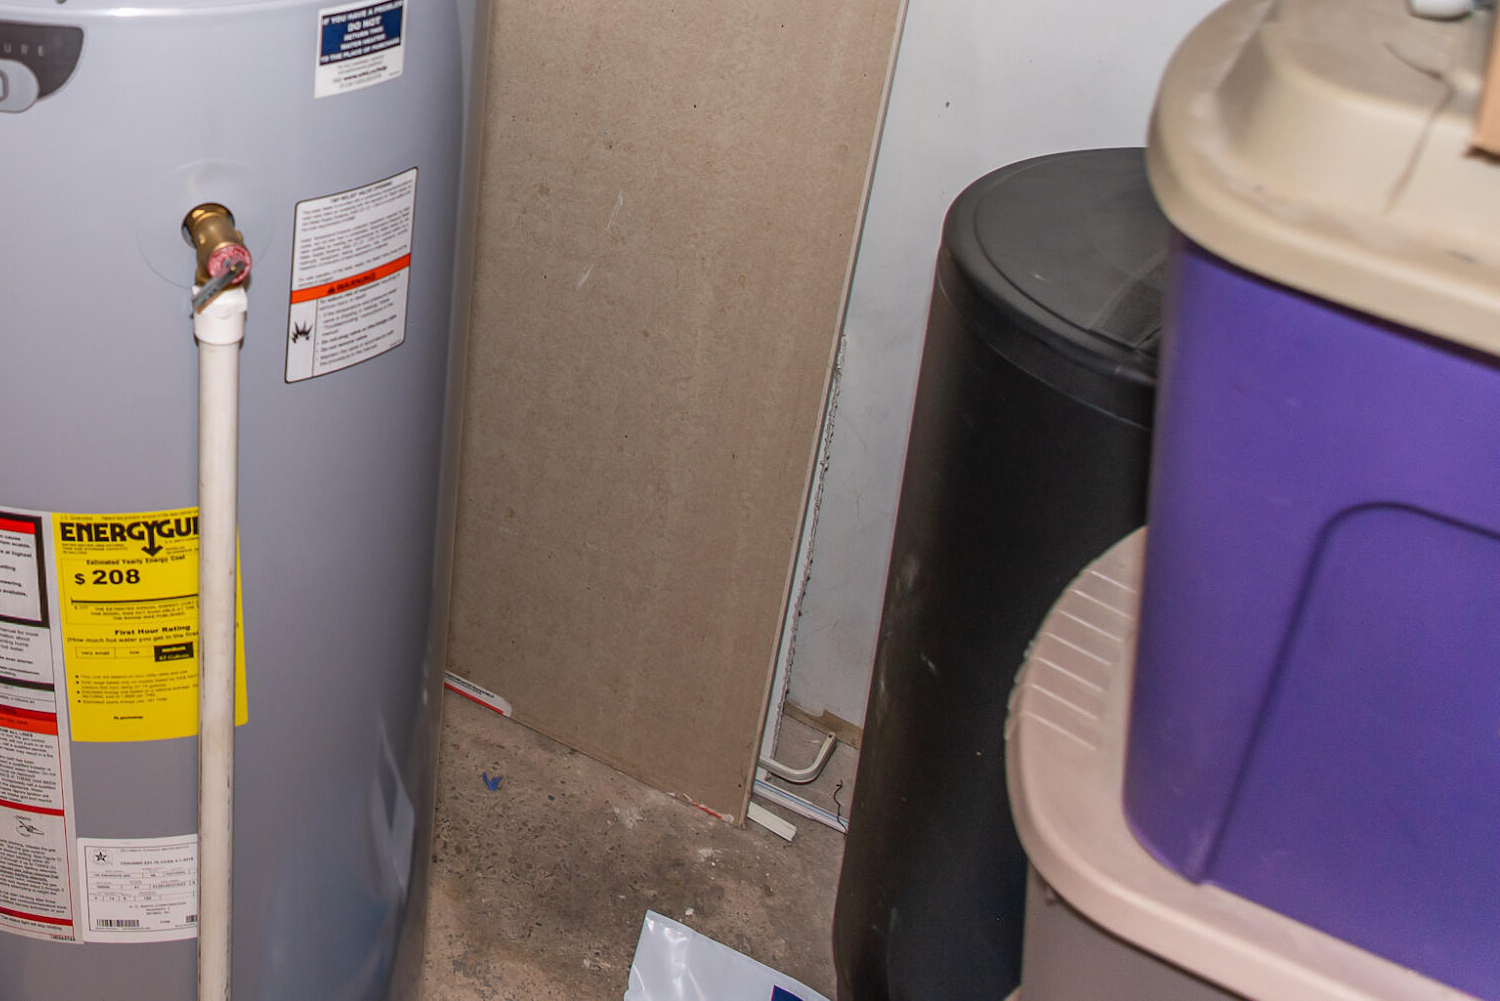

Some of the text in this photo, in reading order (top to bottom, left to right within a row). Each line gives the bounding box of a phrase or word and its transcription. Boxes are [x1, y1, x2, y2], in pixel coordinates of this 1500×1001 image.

[331, 14, 347, 25] YOU
[347, 9, 367, 20] HAVE
[347, 15, 382, 33] DO NOT
[340, 33, 387, 51] WATER HEATER
[86, 554, 186, 567] Estimated Yearly Energy Cost
[74, 568, 141, 587] $ 208
[114, 624, 191, 636] First Hour Rating
